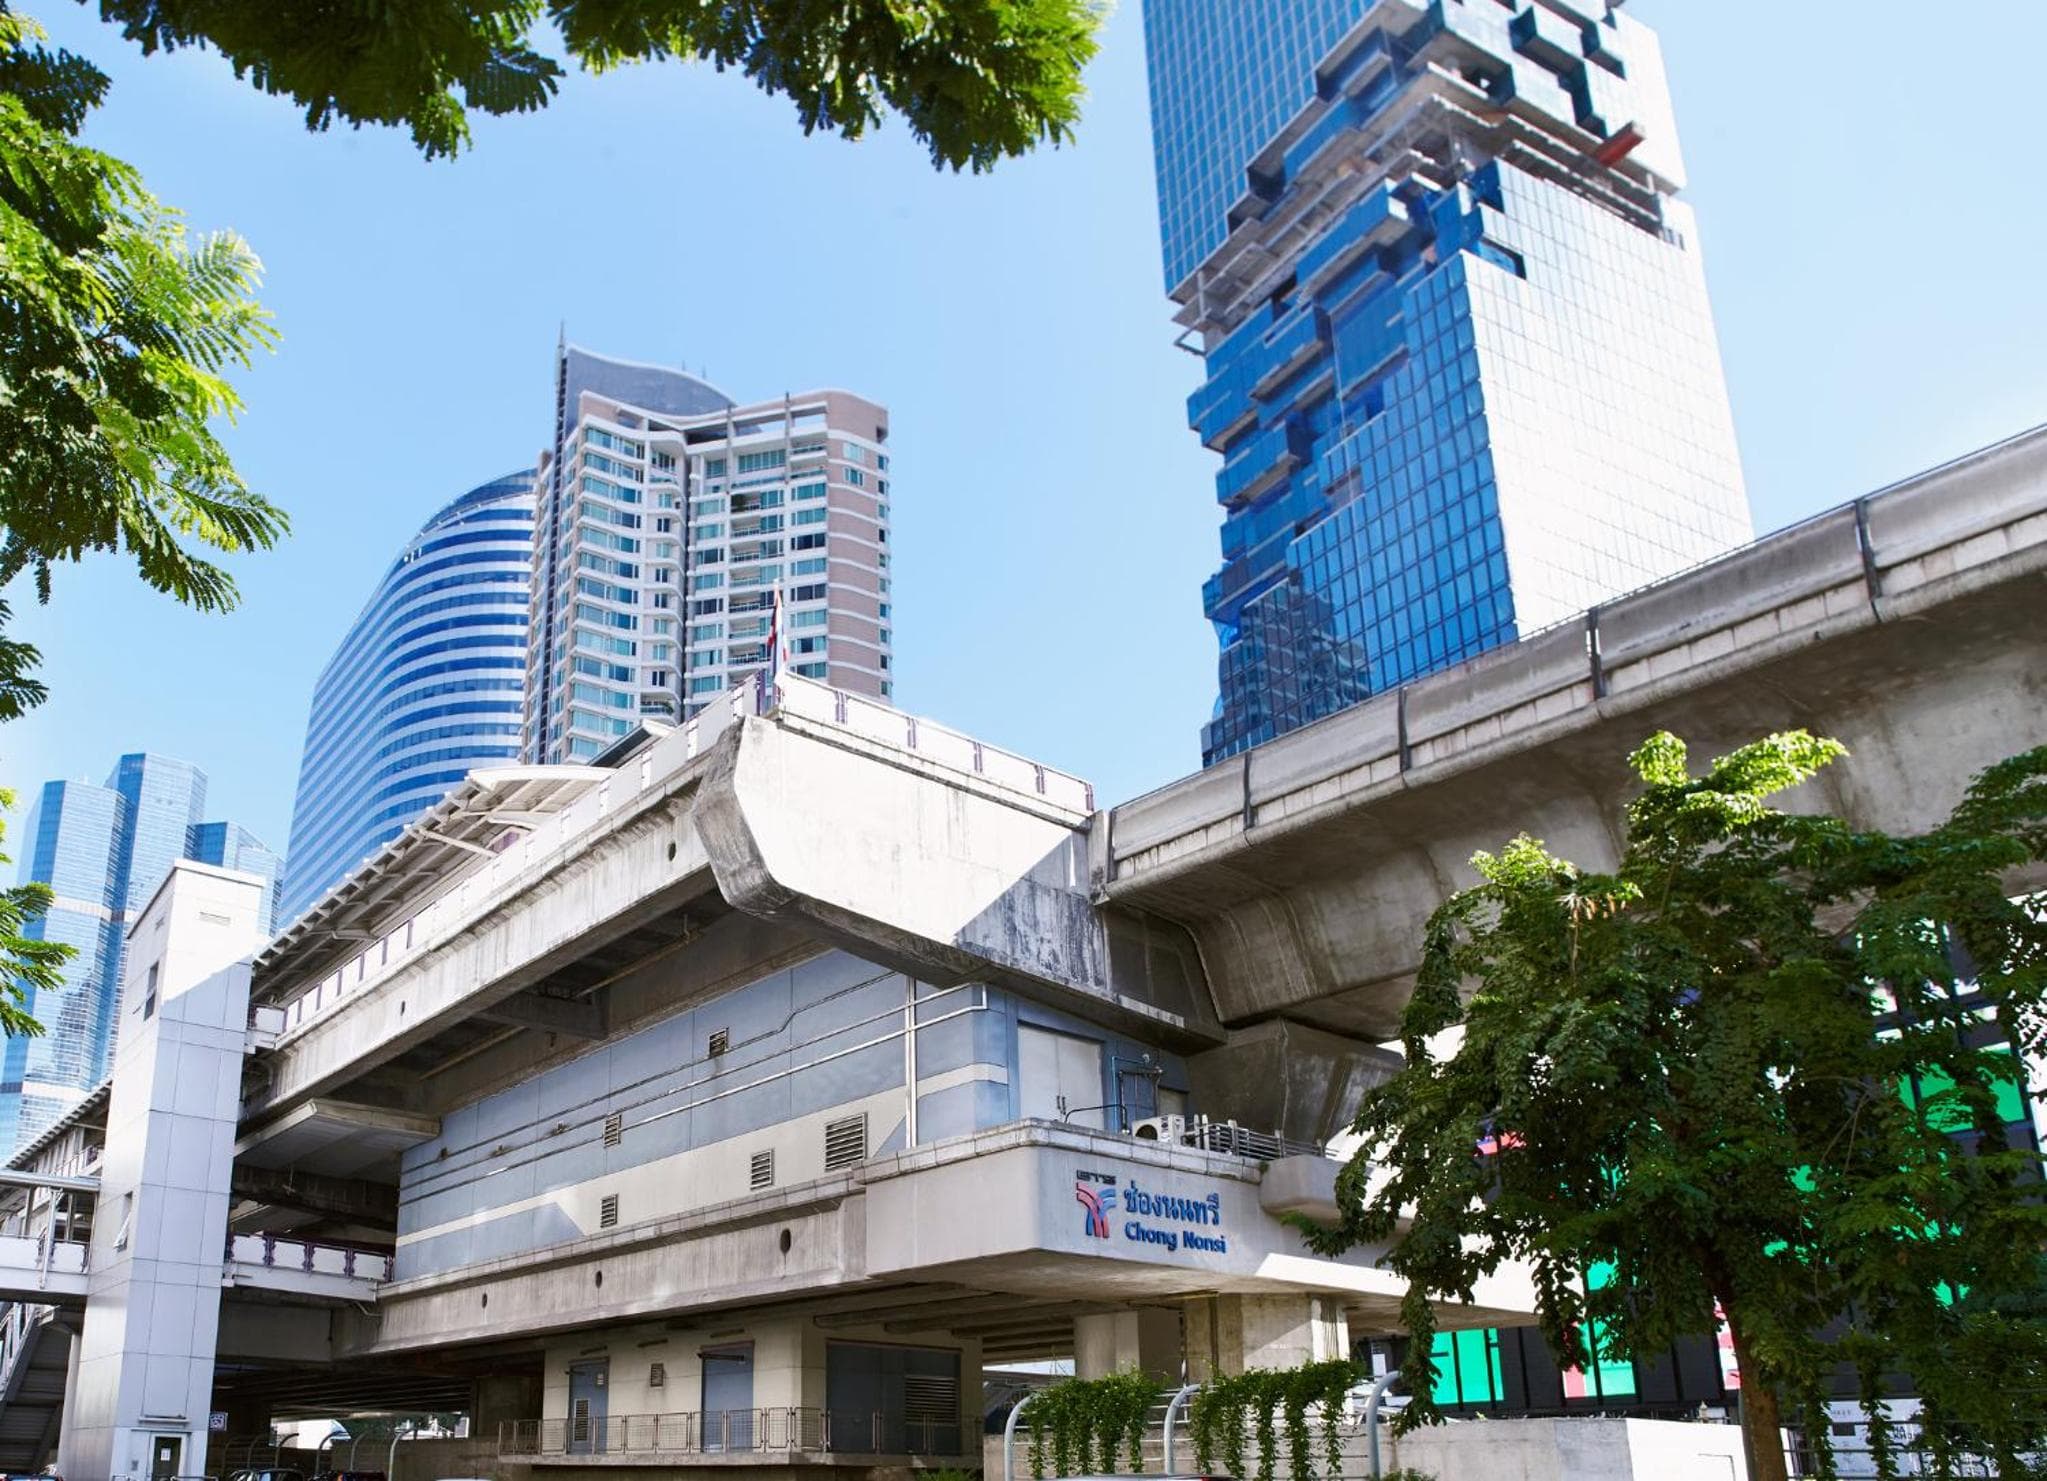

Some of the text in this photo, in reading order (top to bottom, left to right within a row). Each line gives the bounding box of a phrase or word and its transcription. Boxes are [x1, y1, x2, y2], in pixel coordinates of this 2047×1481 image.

[1123, 1180, 1220, 1225] ช่องนนทรี
[1125, 1221, 1227, 1253] Chong Nonsi
